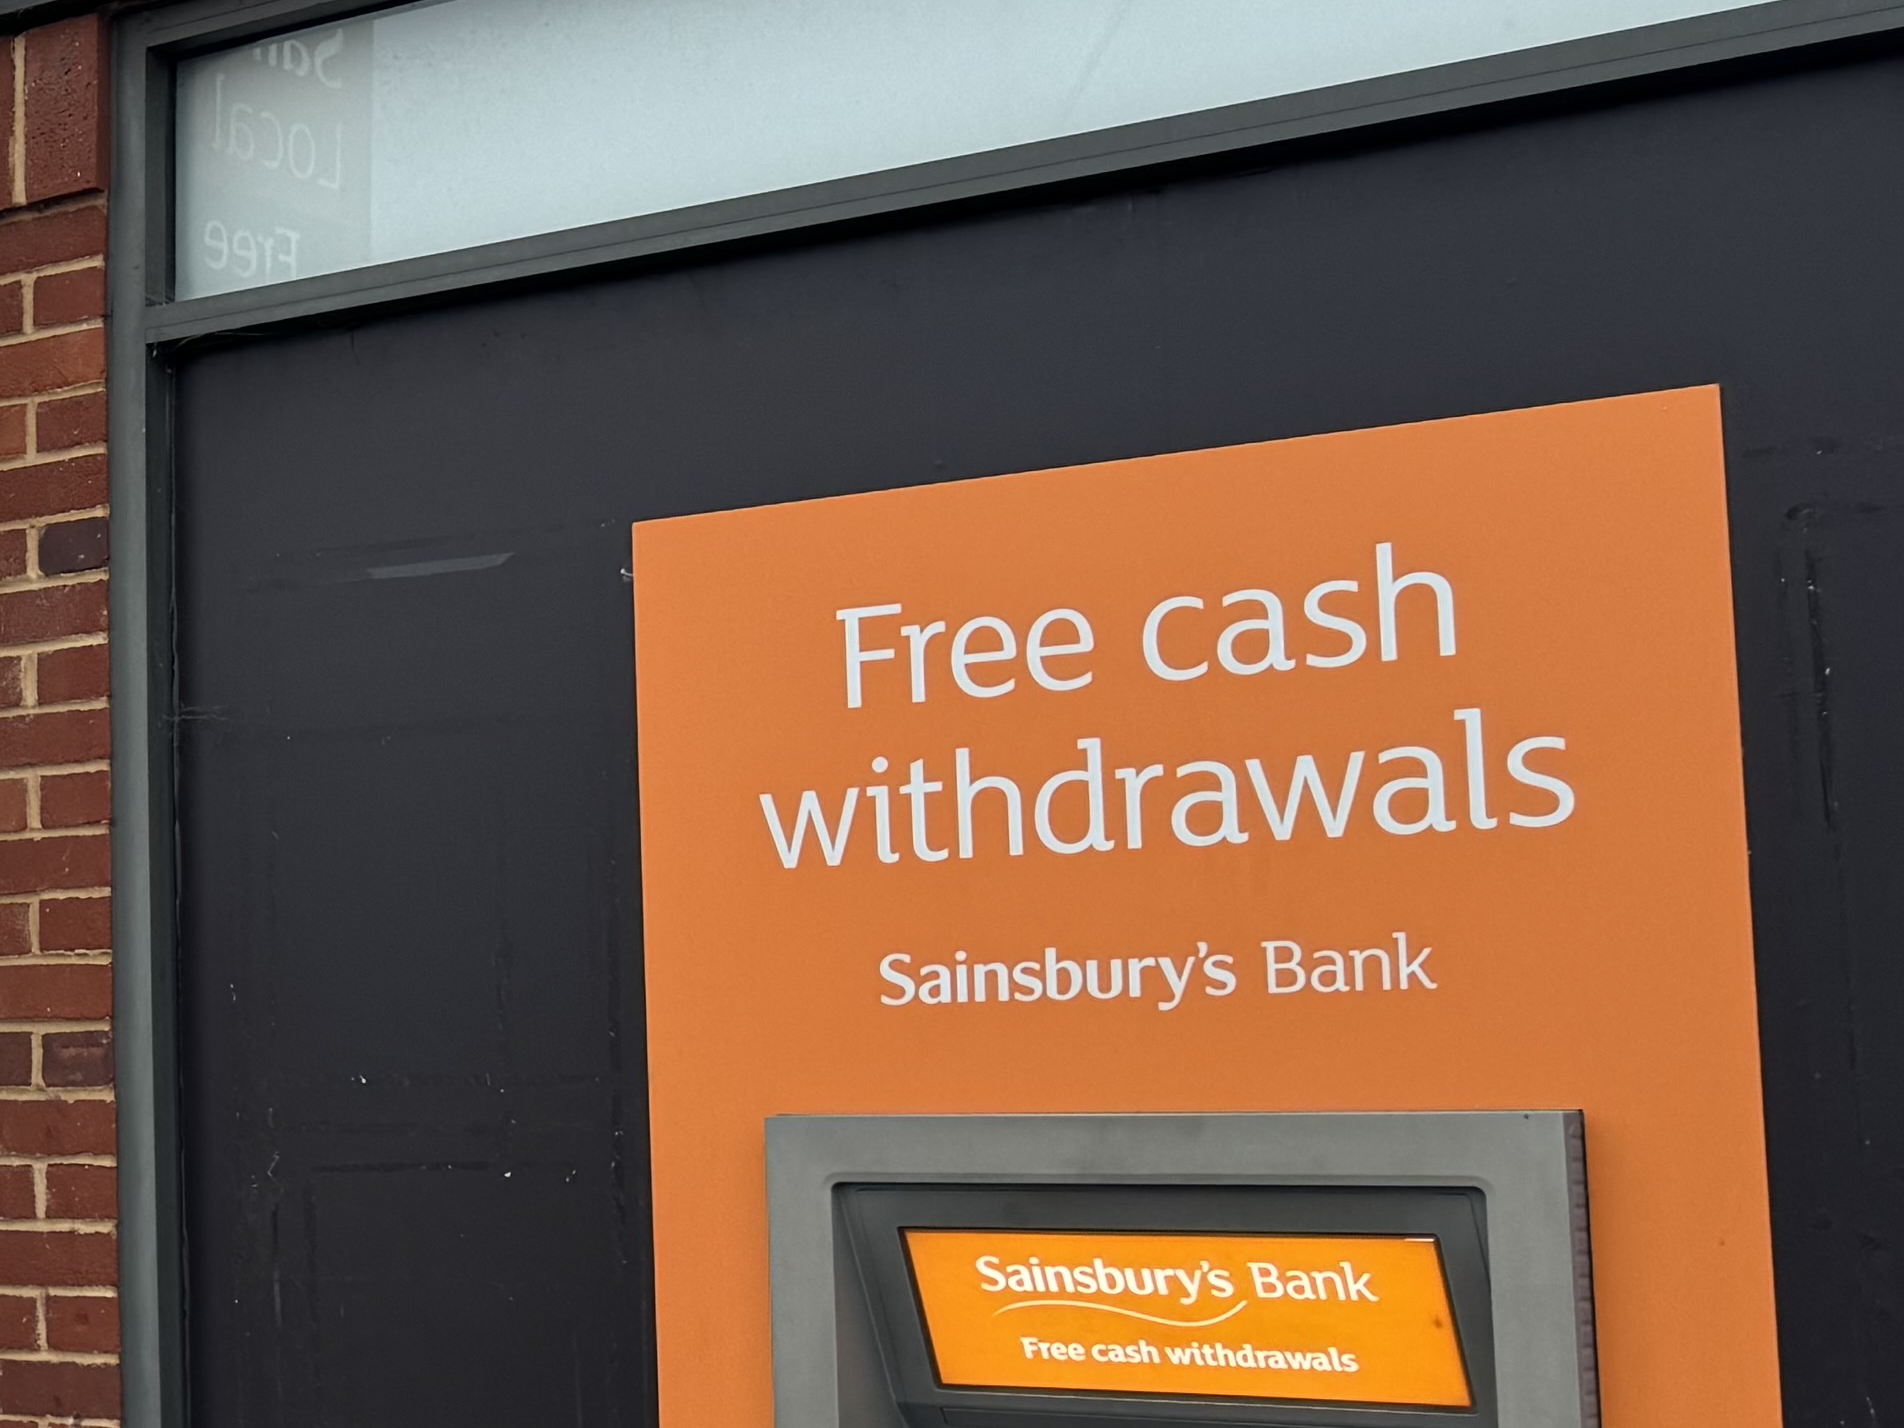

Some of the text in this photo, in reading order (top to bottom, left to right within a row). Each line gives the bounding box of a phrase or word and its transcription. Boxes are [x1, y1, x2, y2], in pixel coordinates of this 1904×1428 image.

[836, 542, 1456, 708] Free cash
[759, 708, 1576, 868] withdrawals
[879, 932, 1437, 1011] Sainsbury's Bank
[975, 1256, 1379, 1304] Sainsbury's Bank
[1020, 1337, 1359, 1373] Free cash withdrawals
